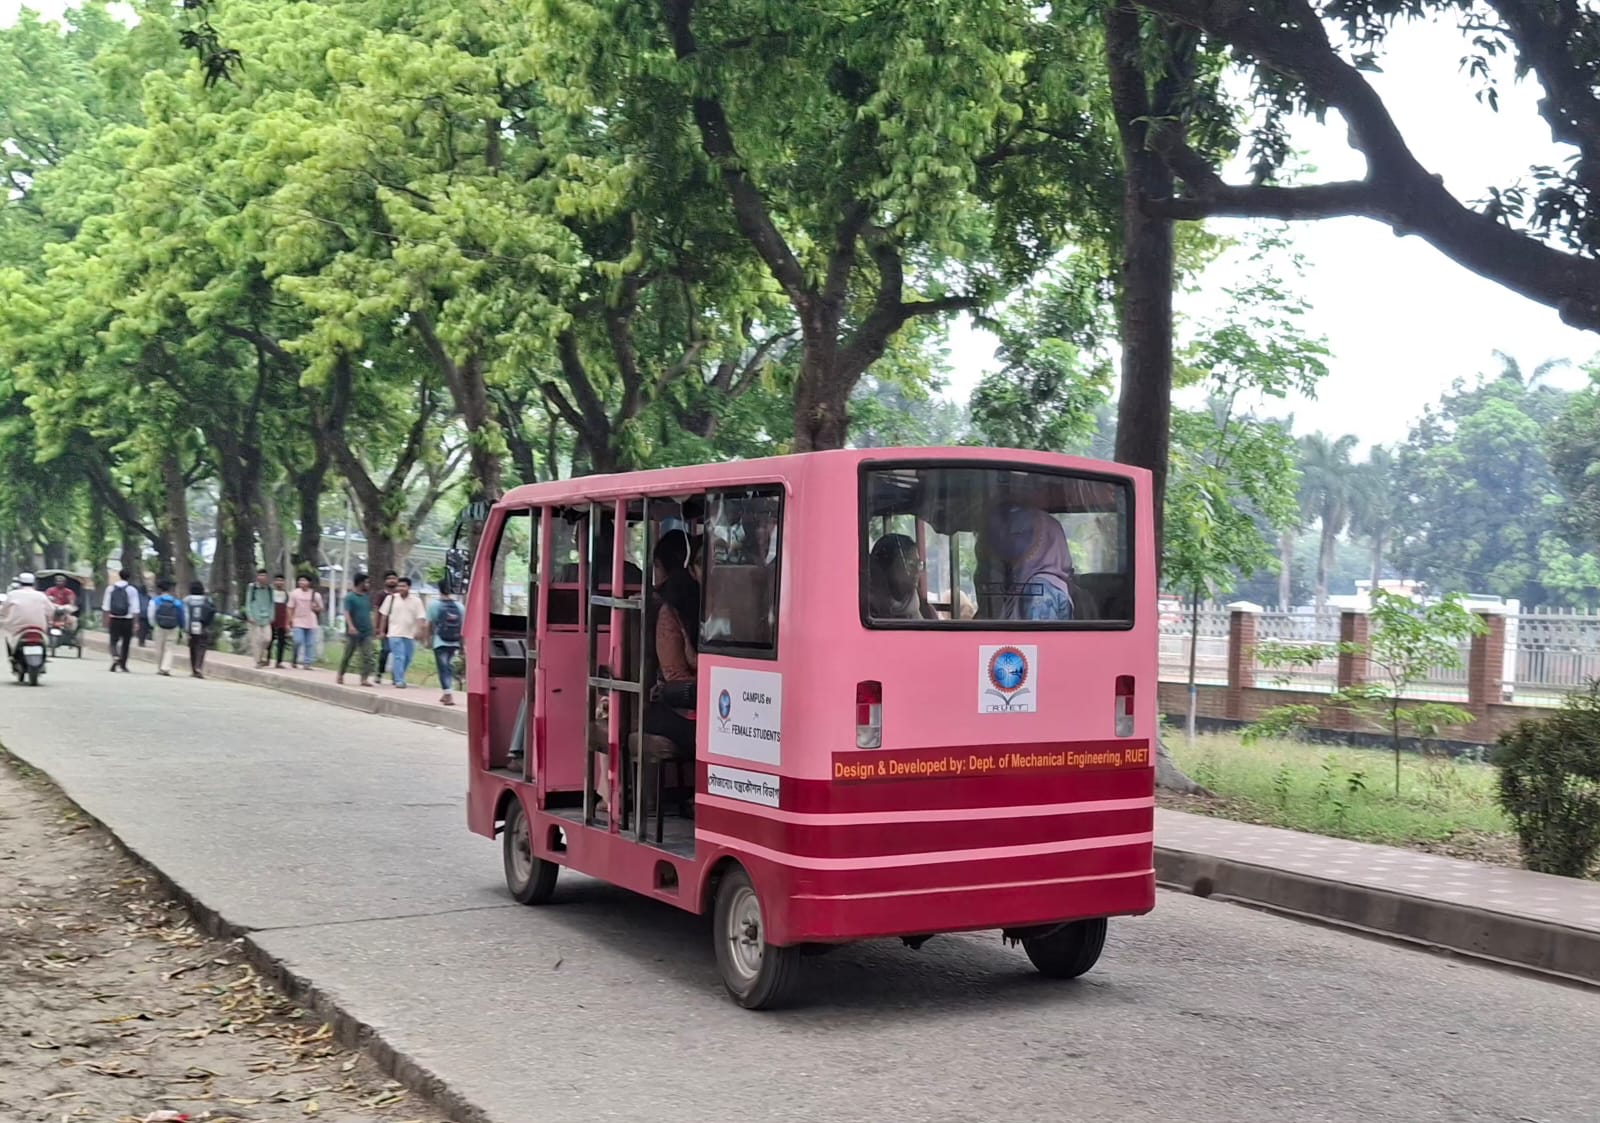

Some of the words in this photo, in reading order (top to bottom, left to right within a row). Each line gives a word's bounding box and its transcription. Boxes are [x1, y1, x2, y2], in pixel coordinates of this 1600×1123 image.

[742, 691, 765, 704] CAMPUS
[731, 724, 753, 737] FEMALE
[753, 728, 781, 742] STUDENTS
[835, 762, 874, 779] Design
[877, 761, 886, 775] &
[889, 757, 947, 776] Developed
[950, 758, 966, 774] by:
[969, 755, 996, 772] Dept.
[998, 754, 1010, 768] of
[1011, 752, 1065, 768] Mechanical
[1067, 750, 1123, 768] Engineering,
[1125, 748, 1148, 762] RUET
